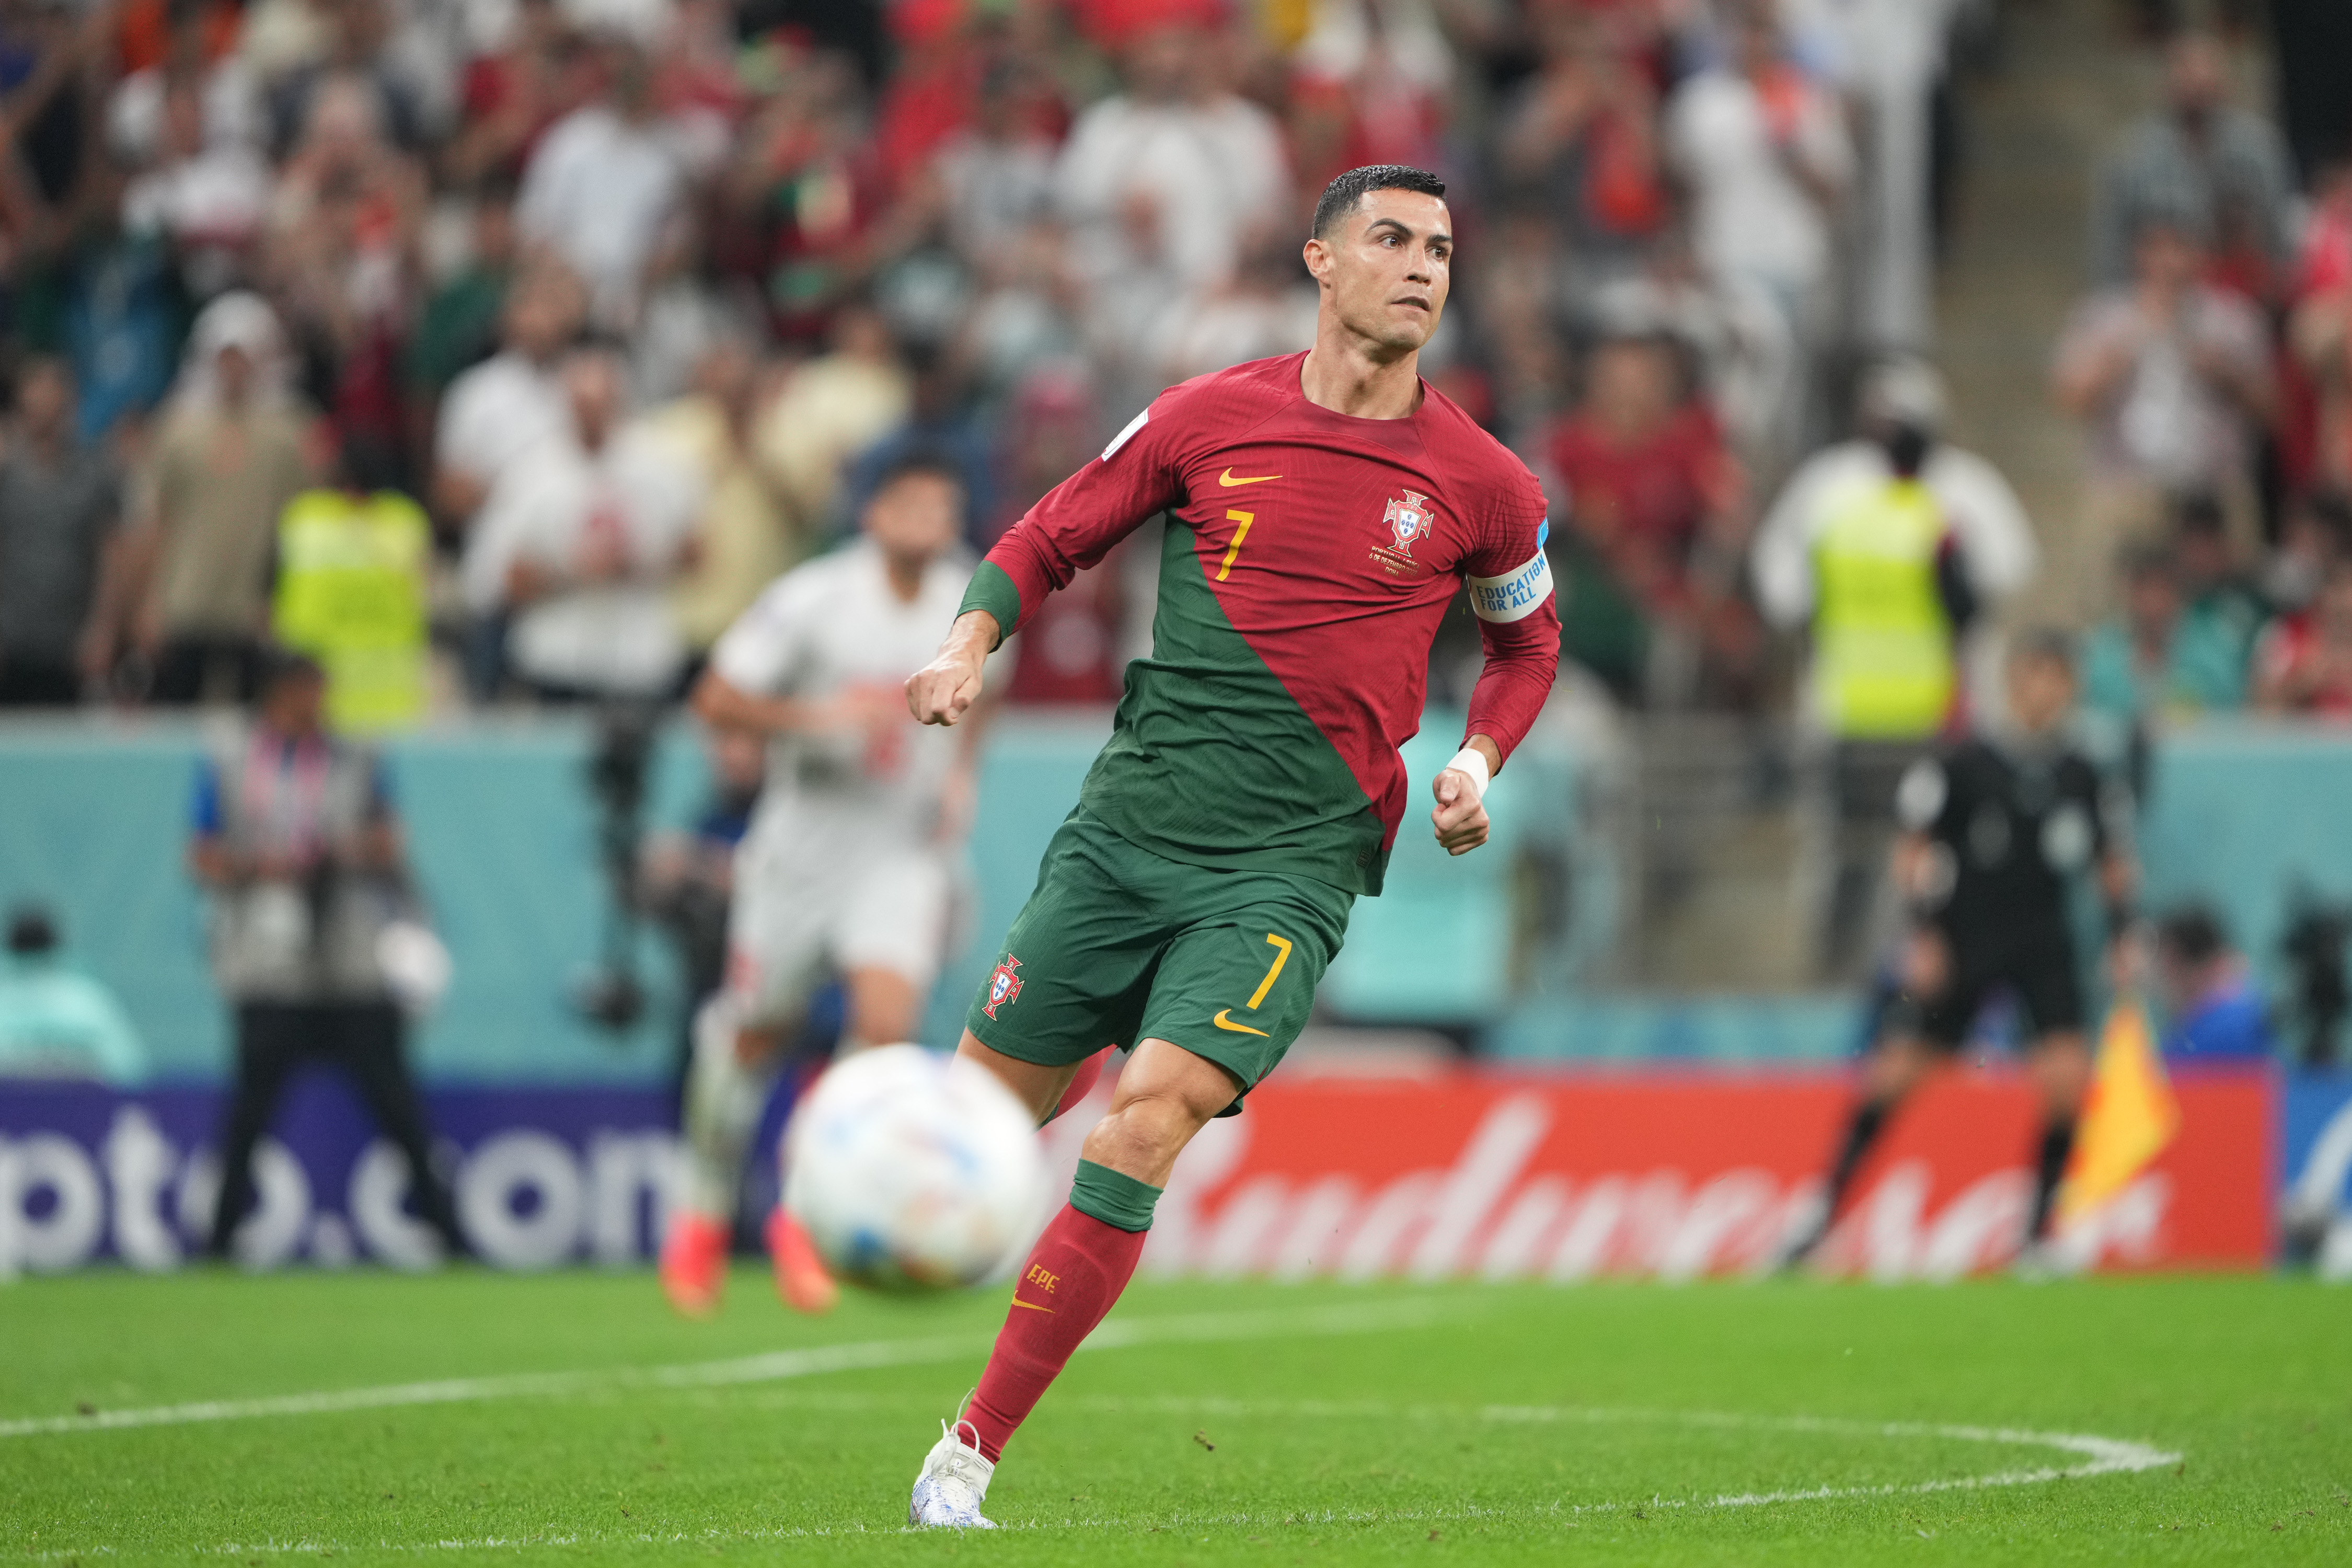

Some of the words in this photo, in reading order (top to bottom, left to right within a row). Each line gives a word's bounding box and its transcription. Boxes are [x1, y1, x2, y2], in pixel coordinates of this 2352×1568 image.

[1215, 510, 1254, 581] 7
[1371, 546, 1400, 562] PORTUGAL
[1380, 556, 1406, 572] DEZEMBRO
[1405, 567, 1418, 577] 2022
[1385, 567, 1399, 577] DOHA
[1476, 554, 1546, 599] EDUCATION
[1480, 598, 1508, 612] FOR
[1513, 586, 1537, 608] ALL
[1246, 933, 1292, 1010] 7
